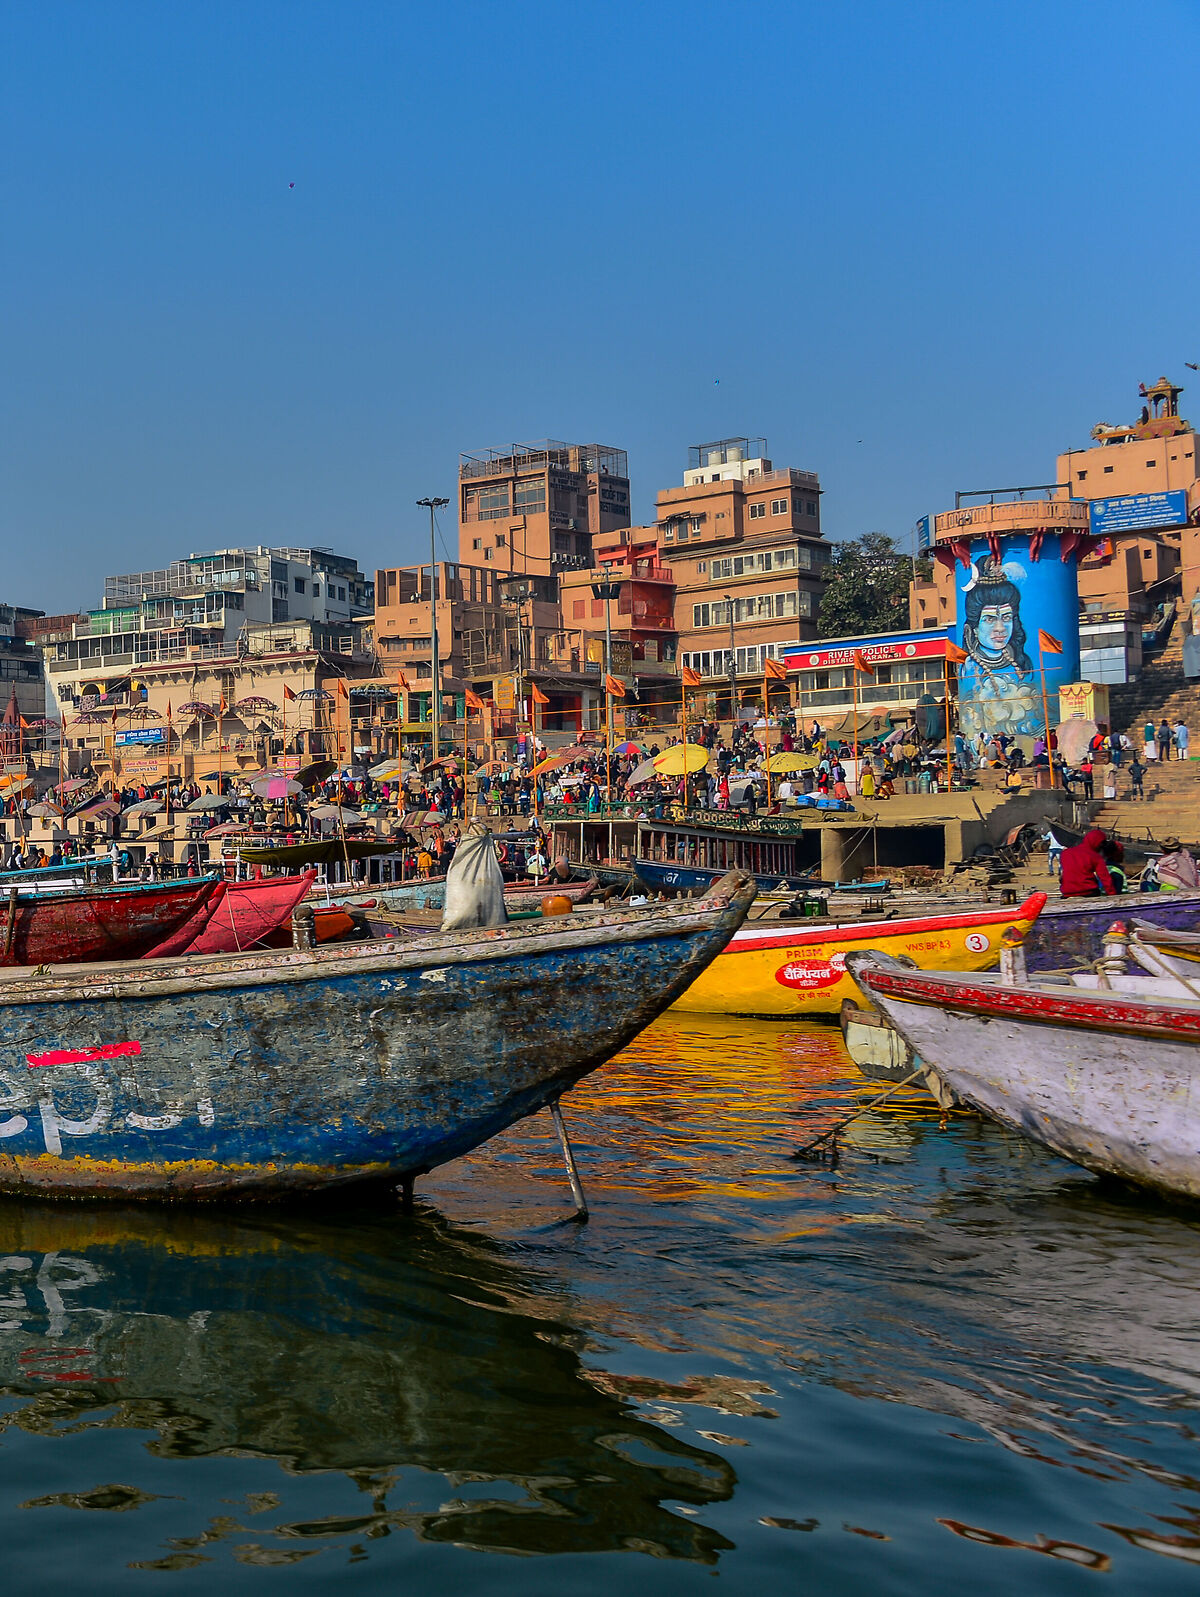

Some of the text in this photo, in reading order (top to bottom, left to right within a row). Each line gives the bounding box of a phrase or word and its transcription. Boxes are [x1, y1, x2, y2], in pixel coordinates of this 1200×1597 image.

[828, 646, 896, 659] RIVER POLICE
[823, 657, 855, 665] DISTRIC
[666, 872, 680, 885] 67
[905, 942, 924, 952] VNS
[925, 940, 938, 951] BP
[969, 935, 984, 951] 3
[786, 948, 824, 959] PRISM
